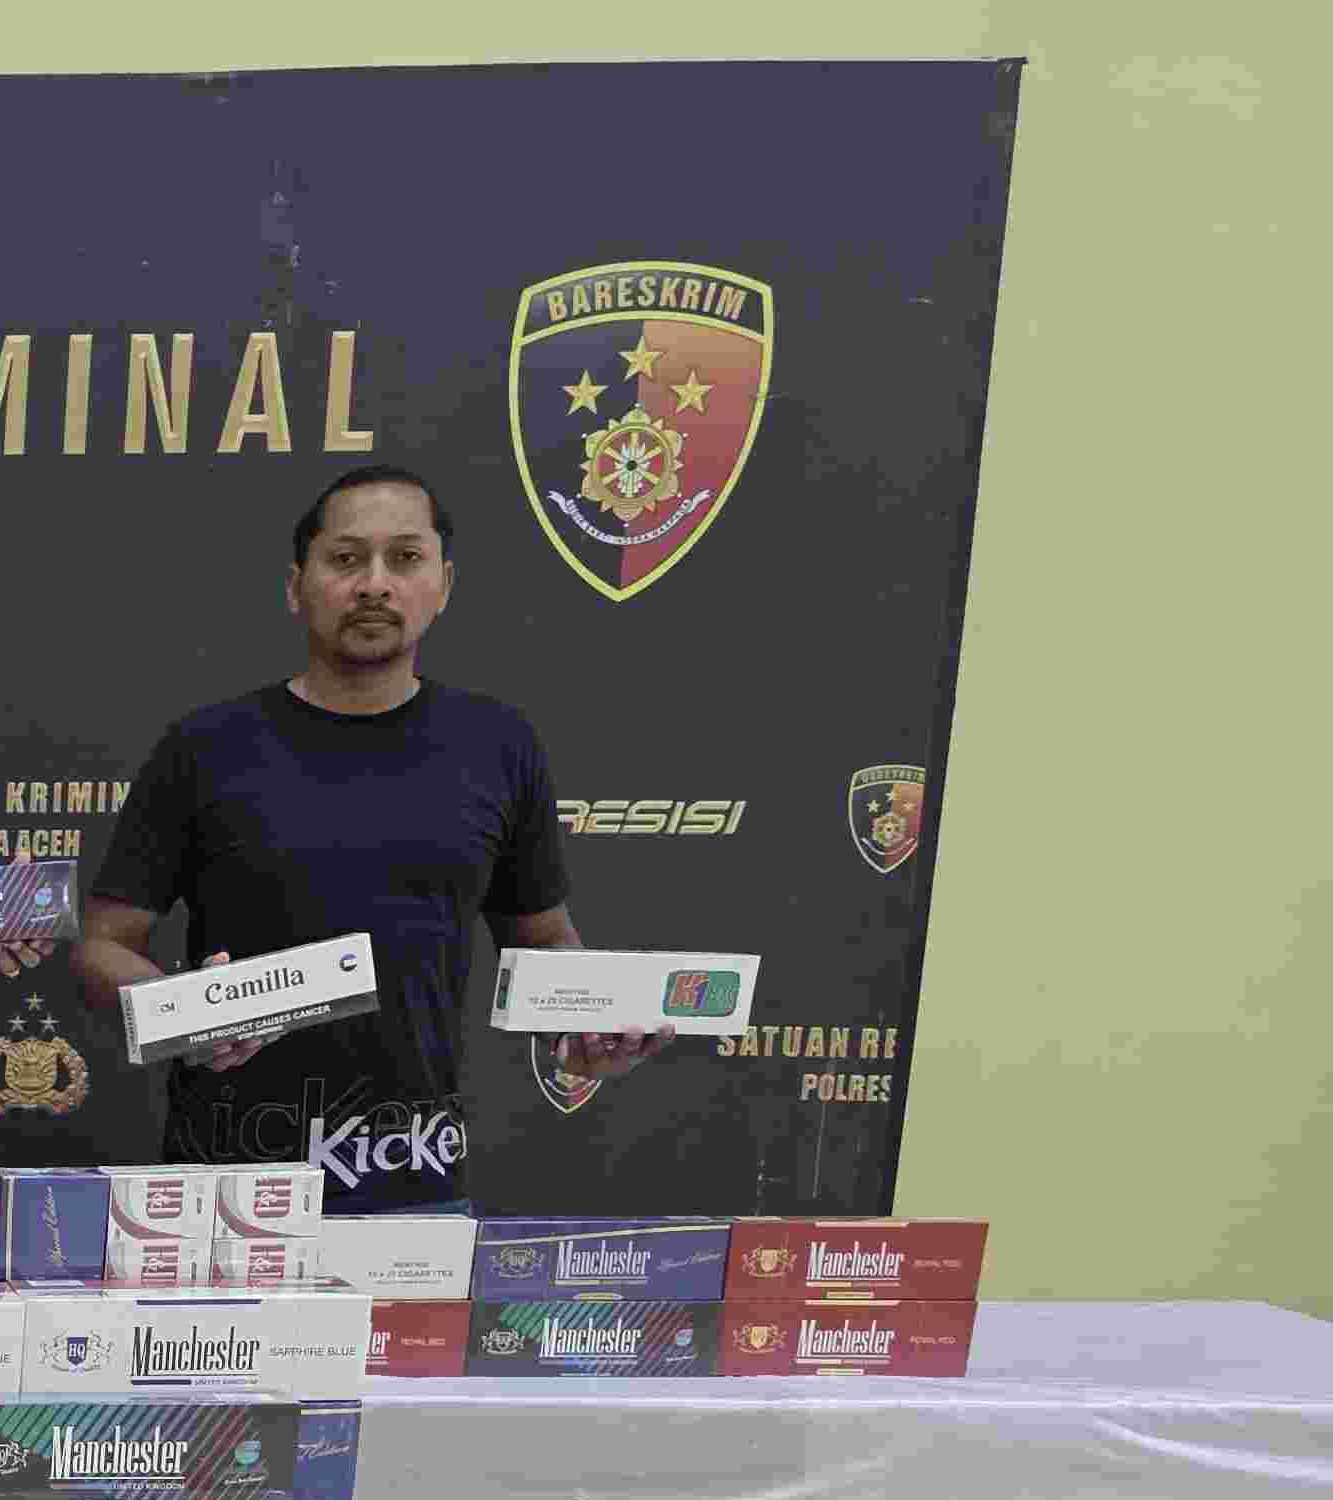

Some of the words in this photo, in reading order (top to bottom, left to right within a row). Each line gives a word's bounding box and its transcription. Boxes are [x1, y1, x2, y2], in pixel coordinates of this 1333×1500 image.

[546, 276, 747, 322] BARESKRIM
[5, 782, 131, 814] KRIMIN
[556, 800, 747, 834] RESISI
[16, 830, 81, 857] ACEH
[205, 966, 305, 1005] Camilla
[717, 1025, 851, 1058] SATUAN
[800, 1073, 893, 1103] POLRES
[555, 1239, 652, 1281] Manchester
[806, 1238, 906, 1281] Manchester
[131, 1322, 261, 1377] Manchester
[269, 1346, 319, 1358] SAPPHIRE
[322, 1346, 357, 1358] BLUE
[796, 1319, 899, 1358] Manchester
[50, 1424, 189, 1479] Manchester
